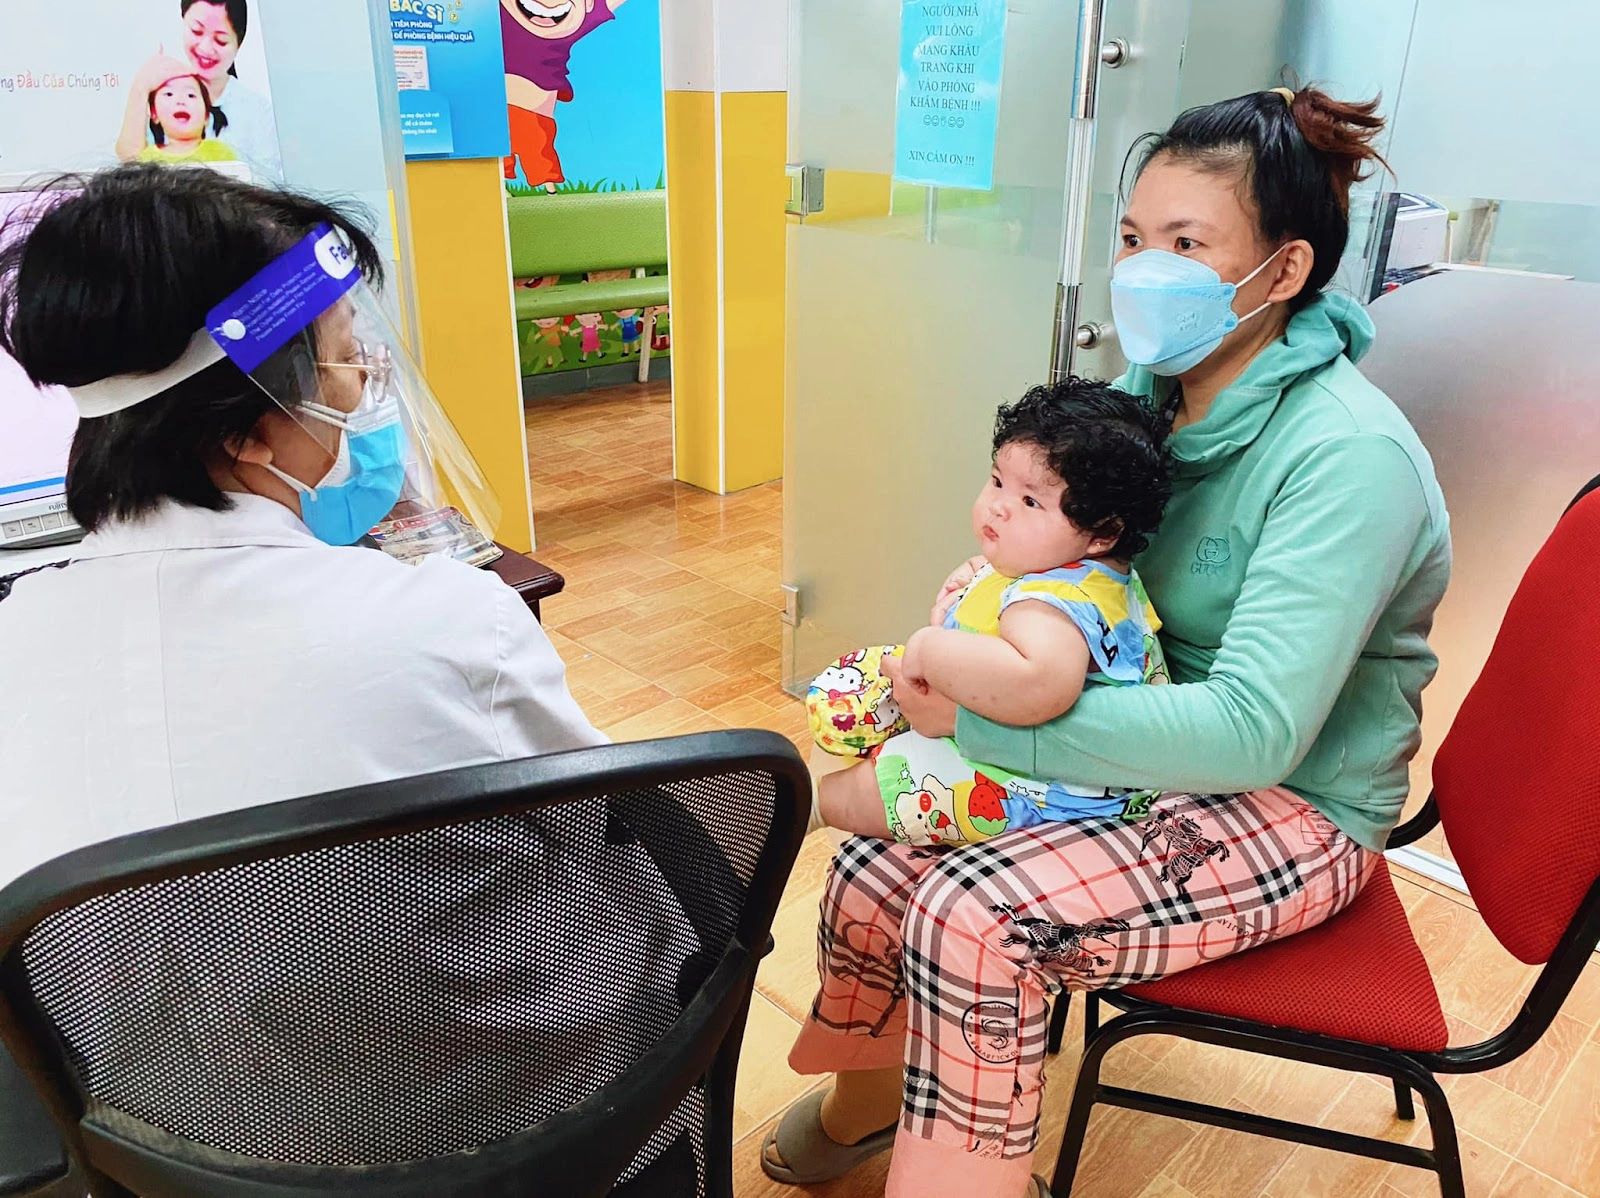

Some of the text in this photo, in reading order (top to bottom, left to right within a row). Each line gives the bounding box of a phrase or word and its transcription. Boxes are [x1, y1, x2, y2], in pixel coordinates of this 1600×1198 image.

[410, 20, 432, 28] PHÒNG
[925, 22, 973, 37] VUI LÒNG
[918, 44, 948, 55] MANG
[920, 61, 974, 74] TRANG KHI
[0, 77, 14, 92] ng
[67, 73, 101, 91] Chúng
[103, 73, 120, 88] Tôi
[971, 100, 981, 111] !!!
[908, 150, 925, 161] XIN
[965, 155, 975, 166] !!!
